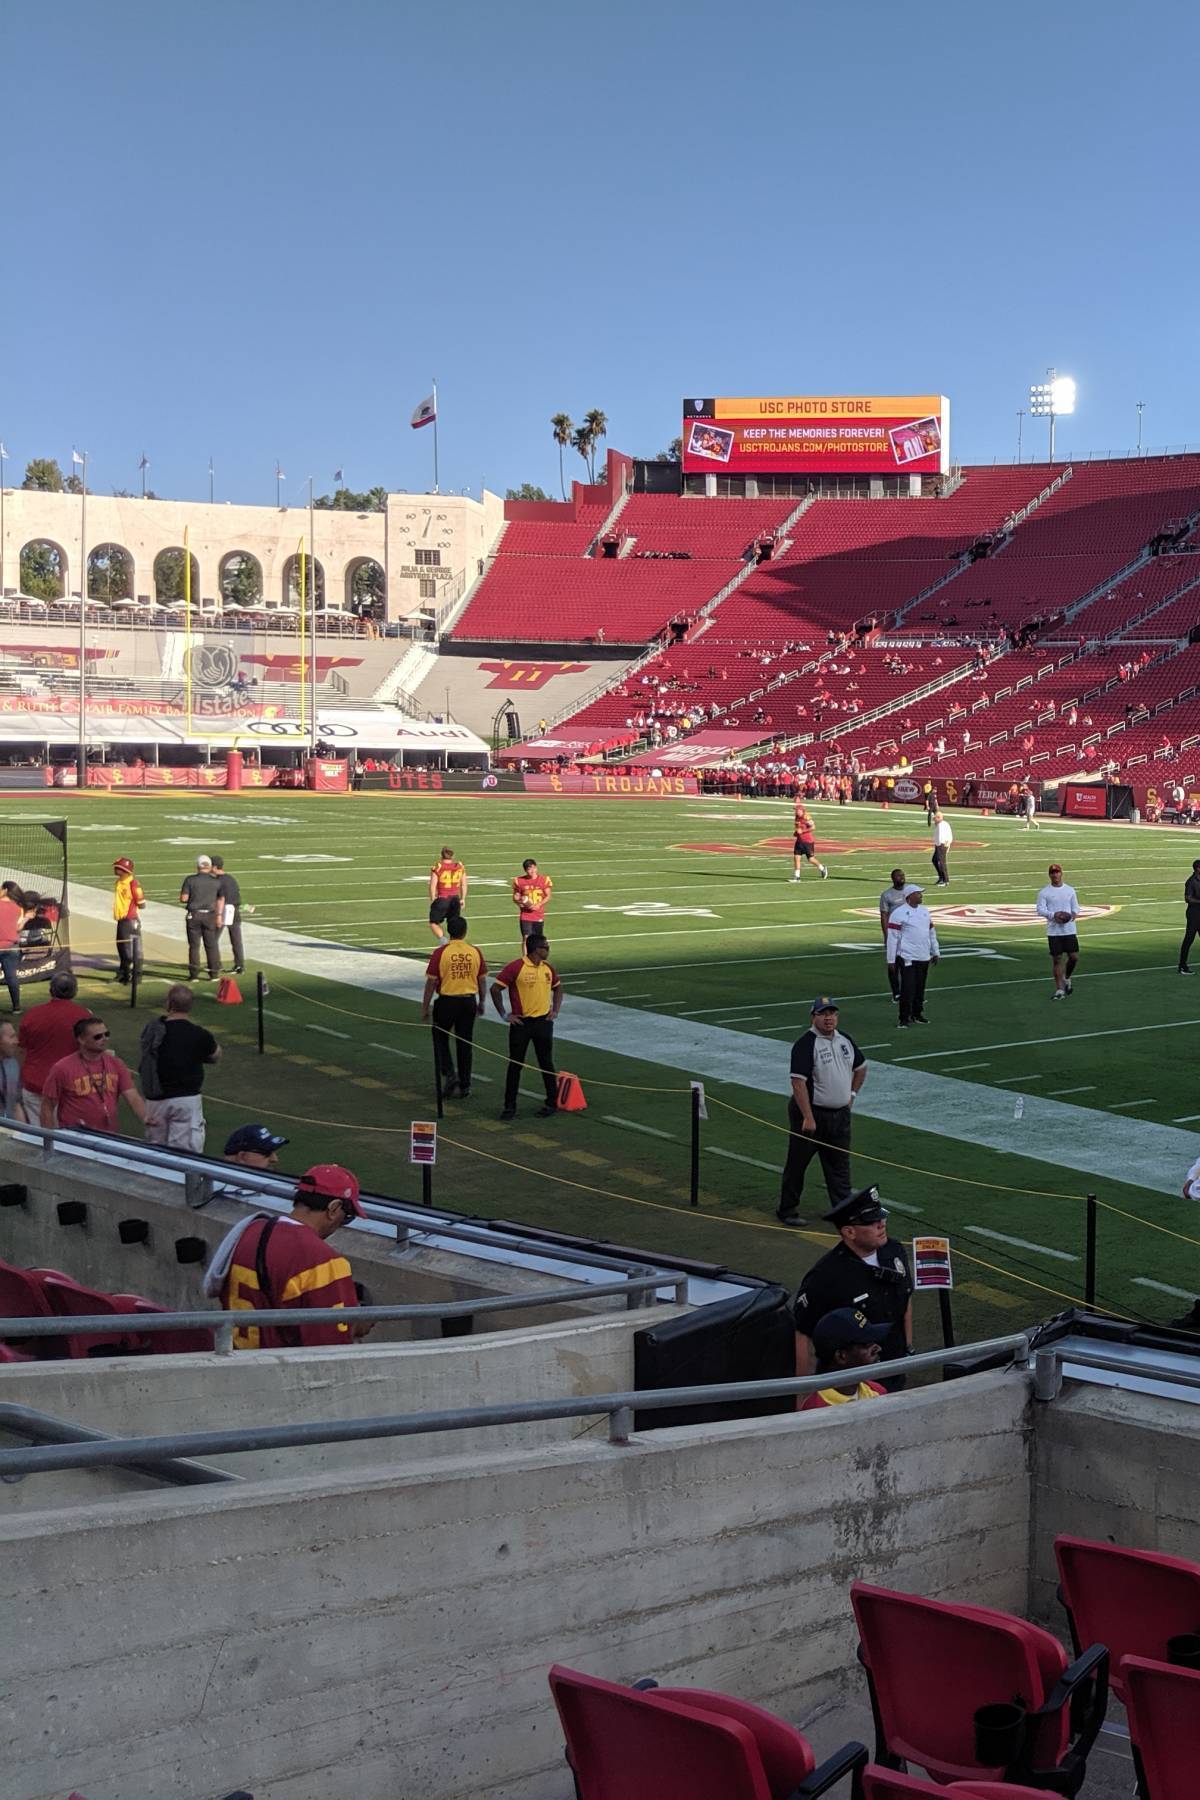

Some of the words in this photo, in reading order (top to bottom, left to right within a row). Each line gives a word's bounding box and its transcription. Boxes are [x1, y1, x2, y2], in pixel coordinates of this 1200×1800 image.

[760, 401, 784, 414] USC
[787, 401, 828, 414] PHOTO
[831, 401, 872, 413] STORE
[743, 428, 767, 438] KEEP
[769, 428, 787, 438] THE
[788, 428, 838, 438] MEMORIES
[839, 427, 885, 438] FOREVER!
[739, 442, 889, 453] USCTROJANS.COM/PHOTOSTORE
[18, 702, 55, 712] RUTH
[118, 703, 161, 715] FAMILY
[397, 729, 468, 738] Audi
[389, 773, 443, 790] UTES
[592, 776, 686, 792] TROJANS
[439, 870, 463, 888] 44
[451, 953, 472, 962] CSC
[451, 962, 472, 971] EVENT
[451, 971, 471, 980] STAFF
